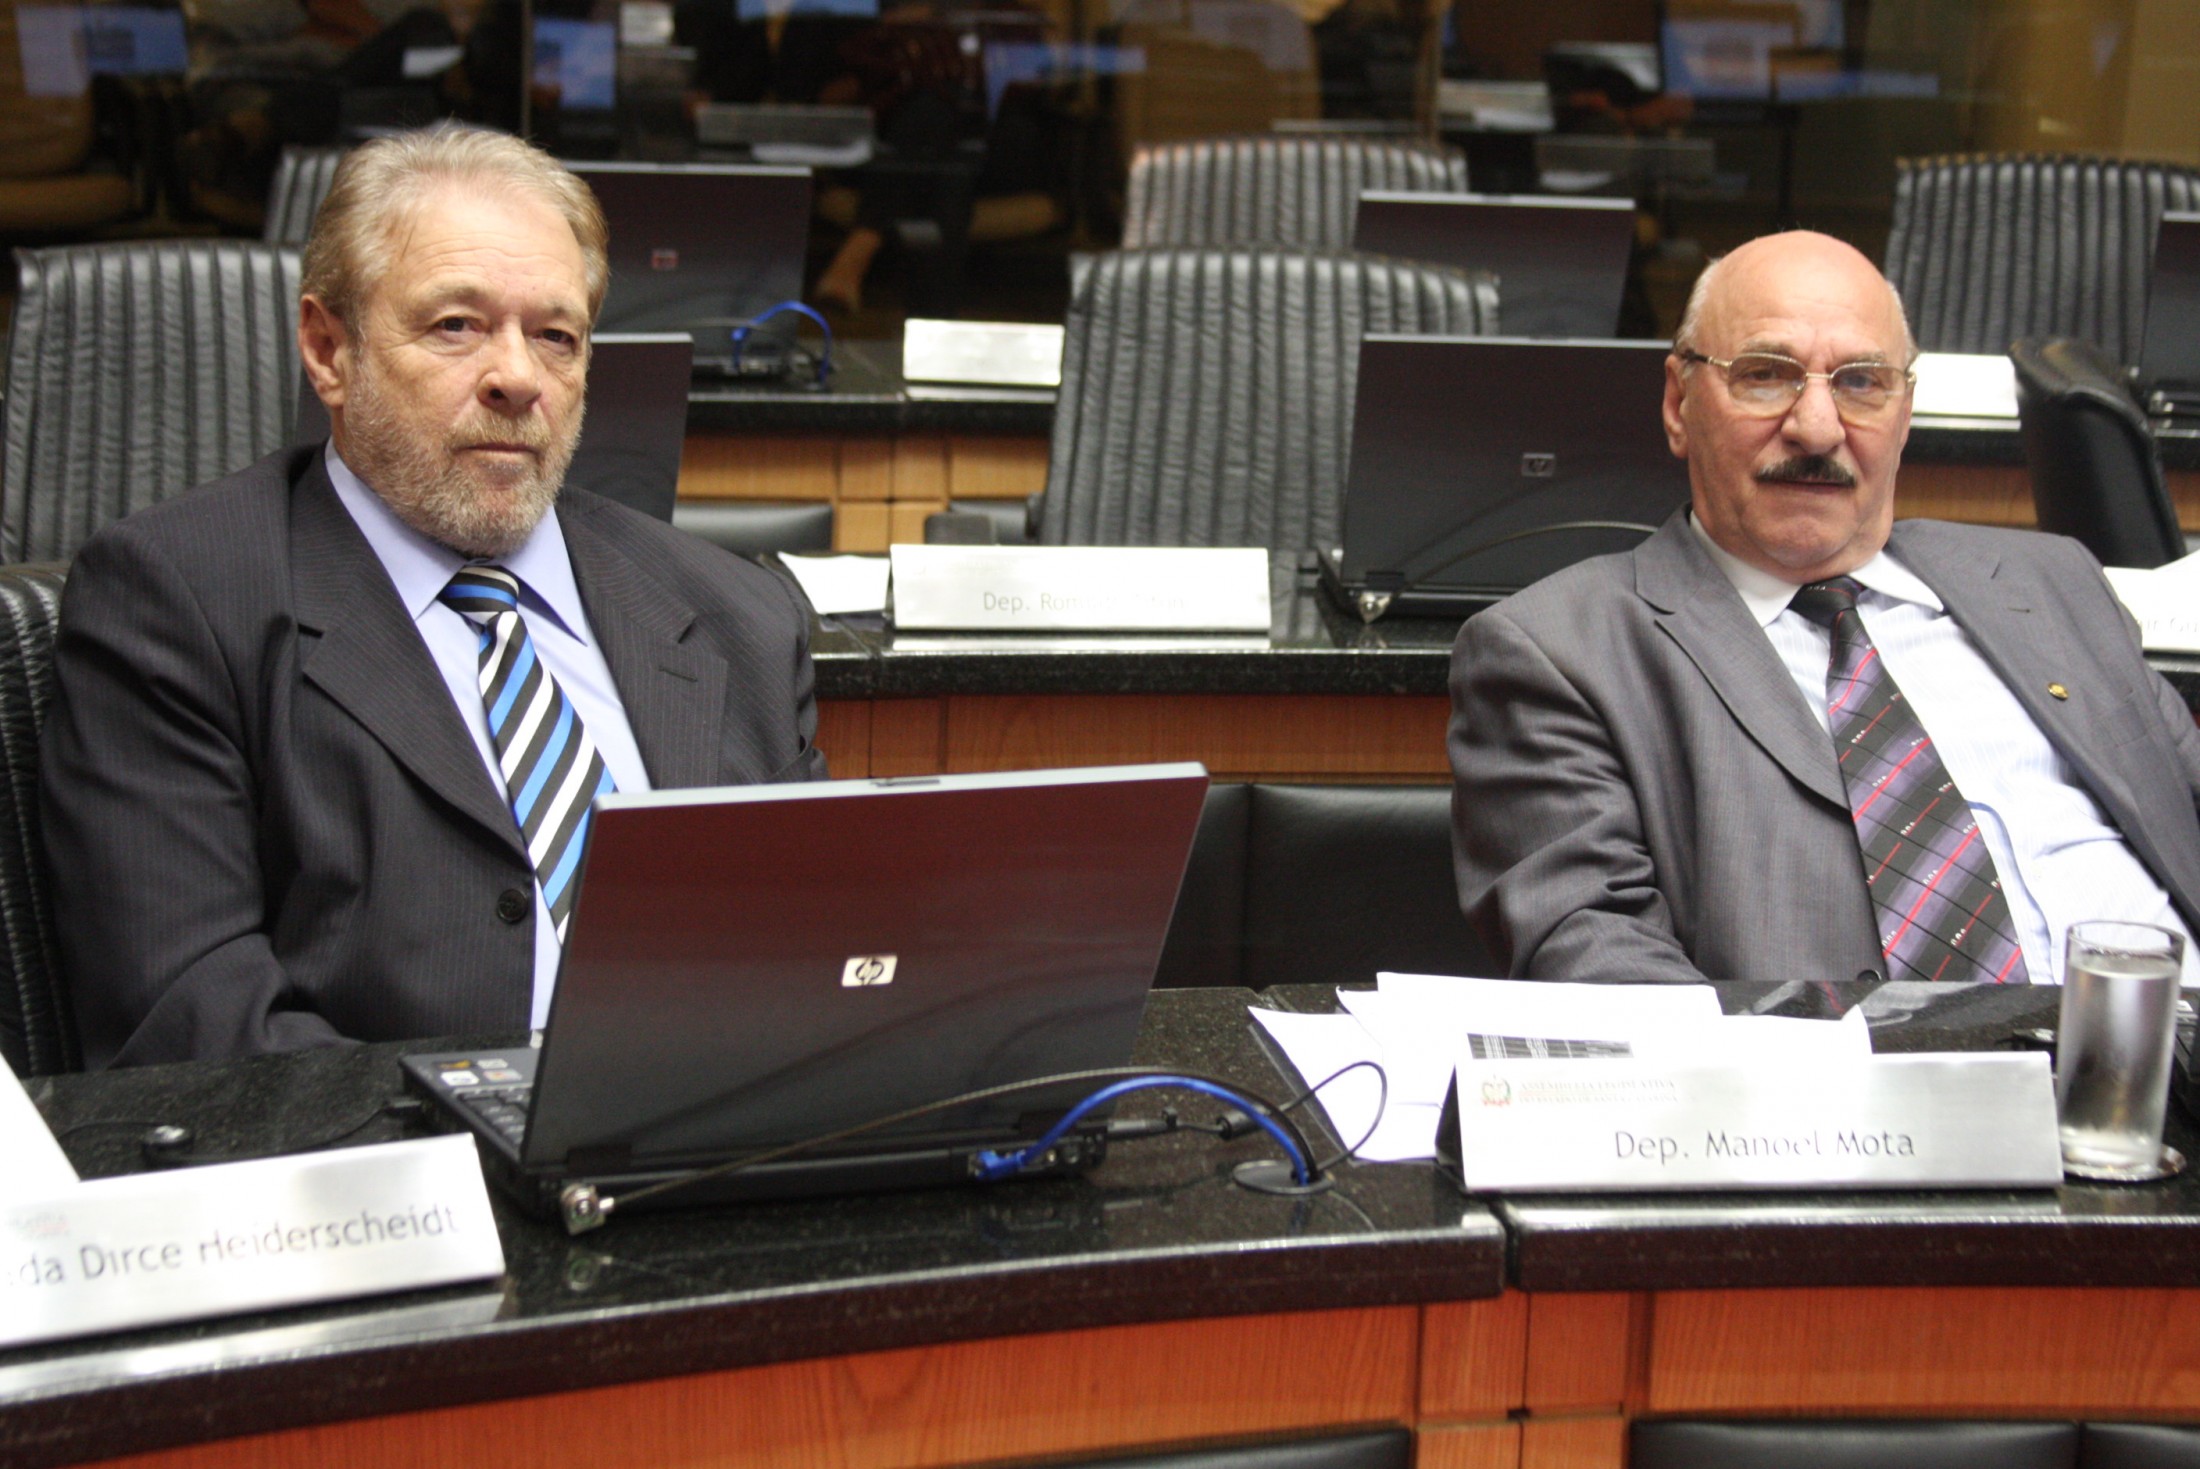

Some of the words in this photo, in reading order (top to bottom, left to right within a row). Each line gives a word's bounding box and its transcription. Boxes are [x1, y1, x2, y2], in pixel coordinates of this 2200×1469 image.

[983, 592, 1030, 614] Dep.
[1615, 1130, 1690, 1166] Dep.
[1705, 1130, 1822, 1158] Manoel
[1836, 1130, 1916, 1158] Mota
[80, 1240, 182, 1281] Dirce
[198, 1204, 460, 1264] Heiderscheidt
